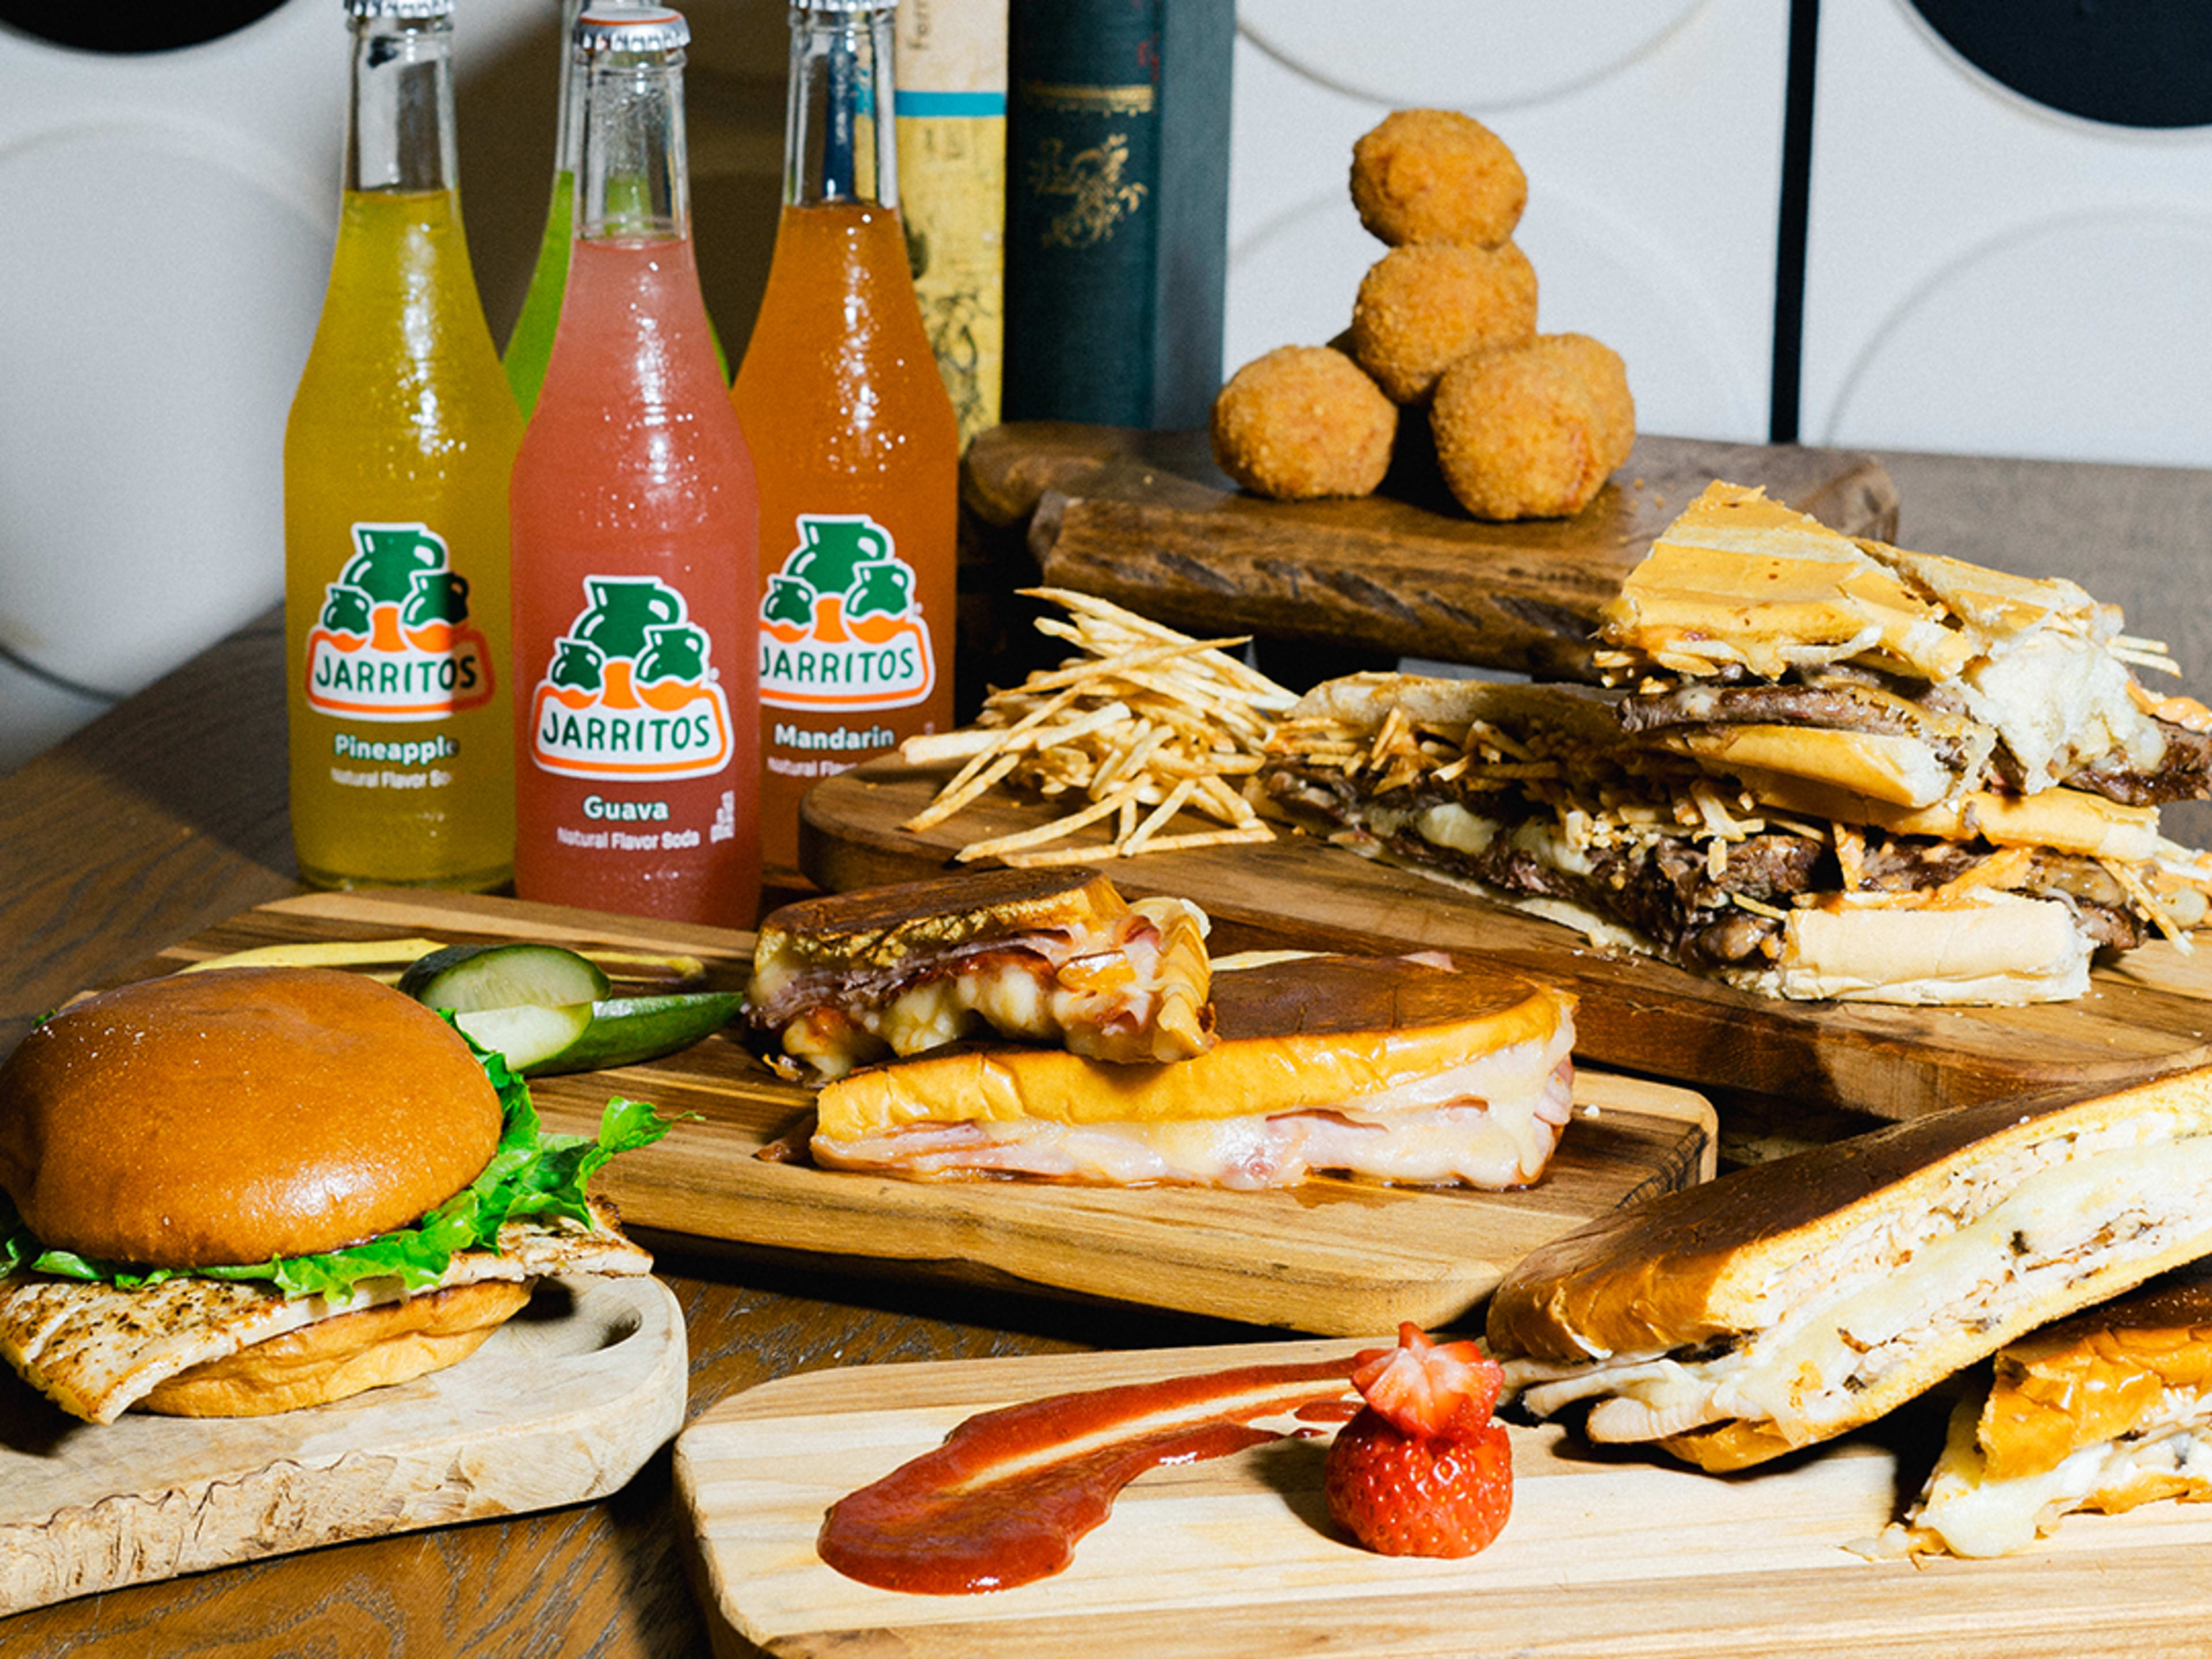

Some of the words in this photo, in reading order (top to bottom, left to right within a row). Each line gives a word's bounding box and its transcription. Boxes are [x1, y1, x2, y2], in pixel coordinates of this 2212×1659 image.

[316, 655, 476, 693] JARRITOS
[760, 646, 914, 683] JARRITOS
[542, 711, 710, 752] JARRITOS
[774, 723, 894, 749] Mandarin
[335, 733, 459, 766] Pineapple
[331, 768, 378, 787] Natural
[381, 771, 427, 789] Flavor
[768, 756, 817, 777] Natural
[583, 794, 669, 820] Guava
[556, 826, 608, 850] Natural
[611, 831, 659, 851] Flavor
[661, 829, 699, 850] Soda
